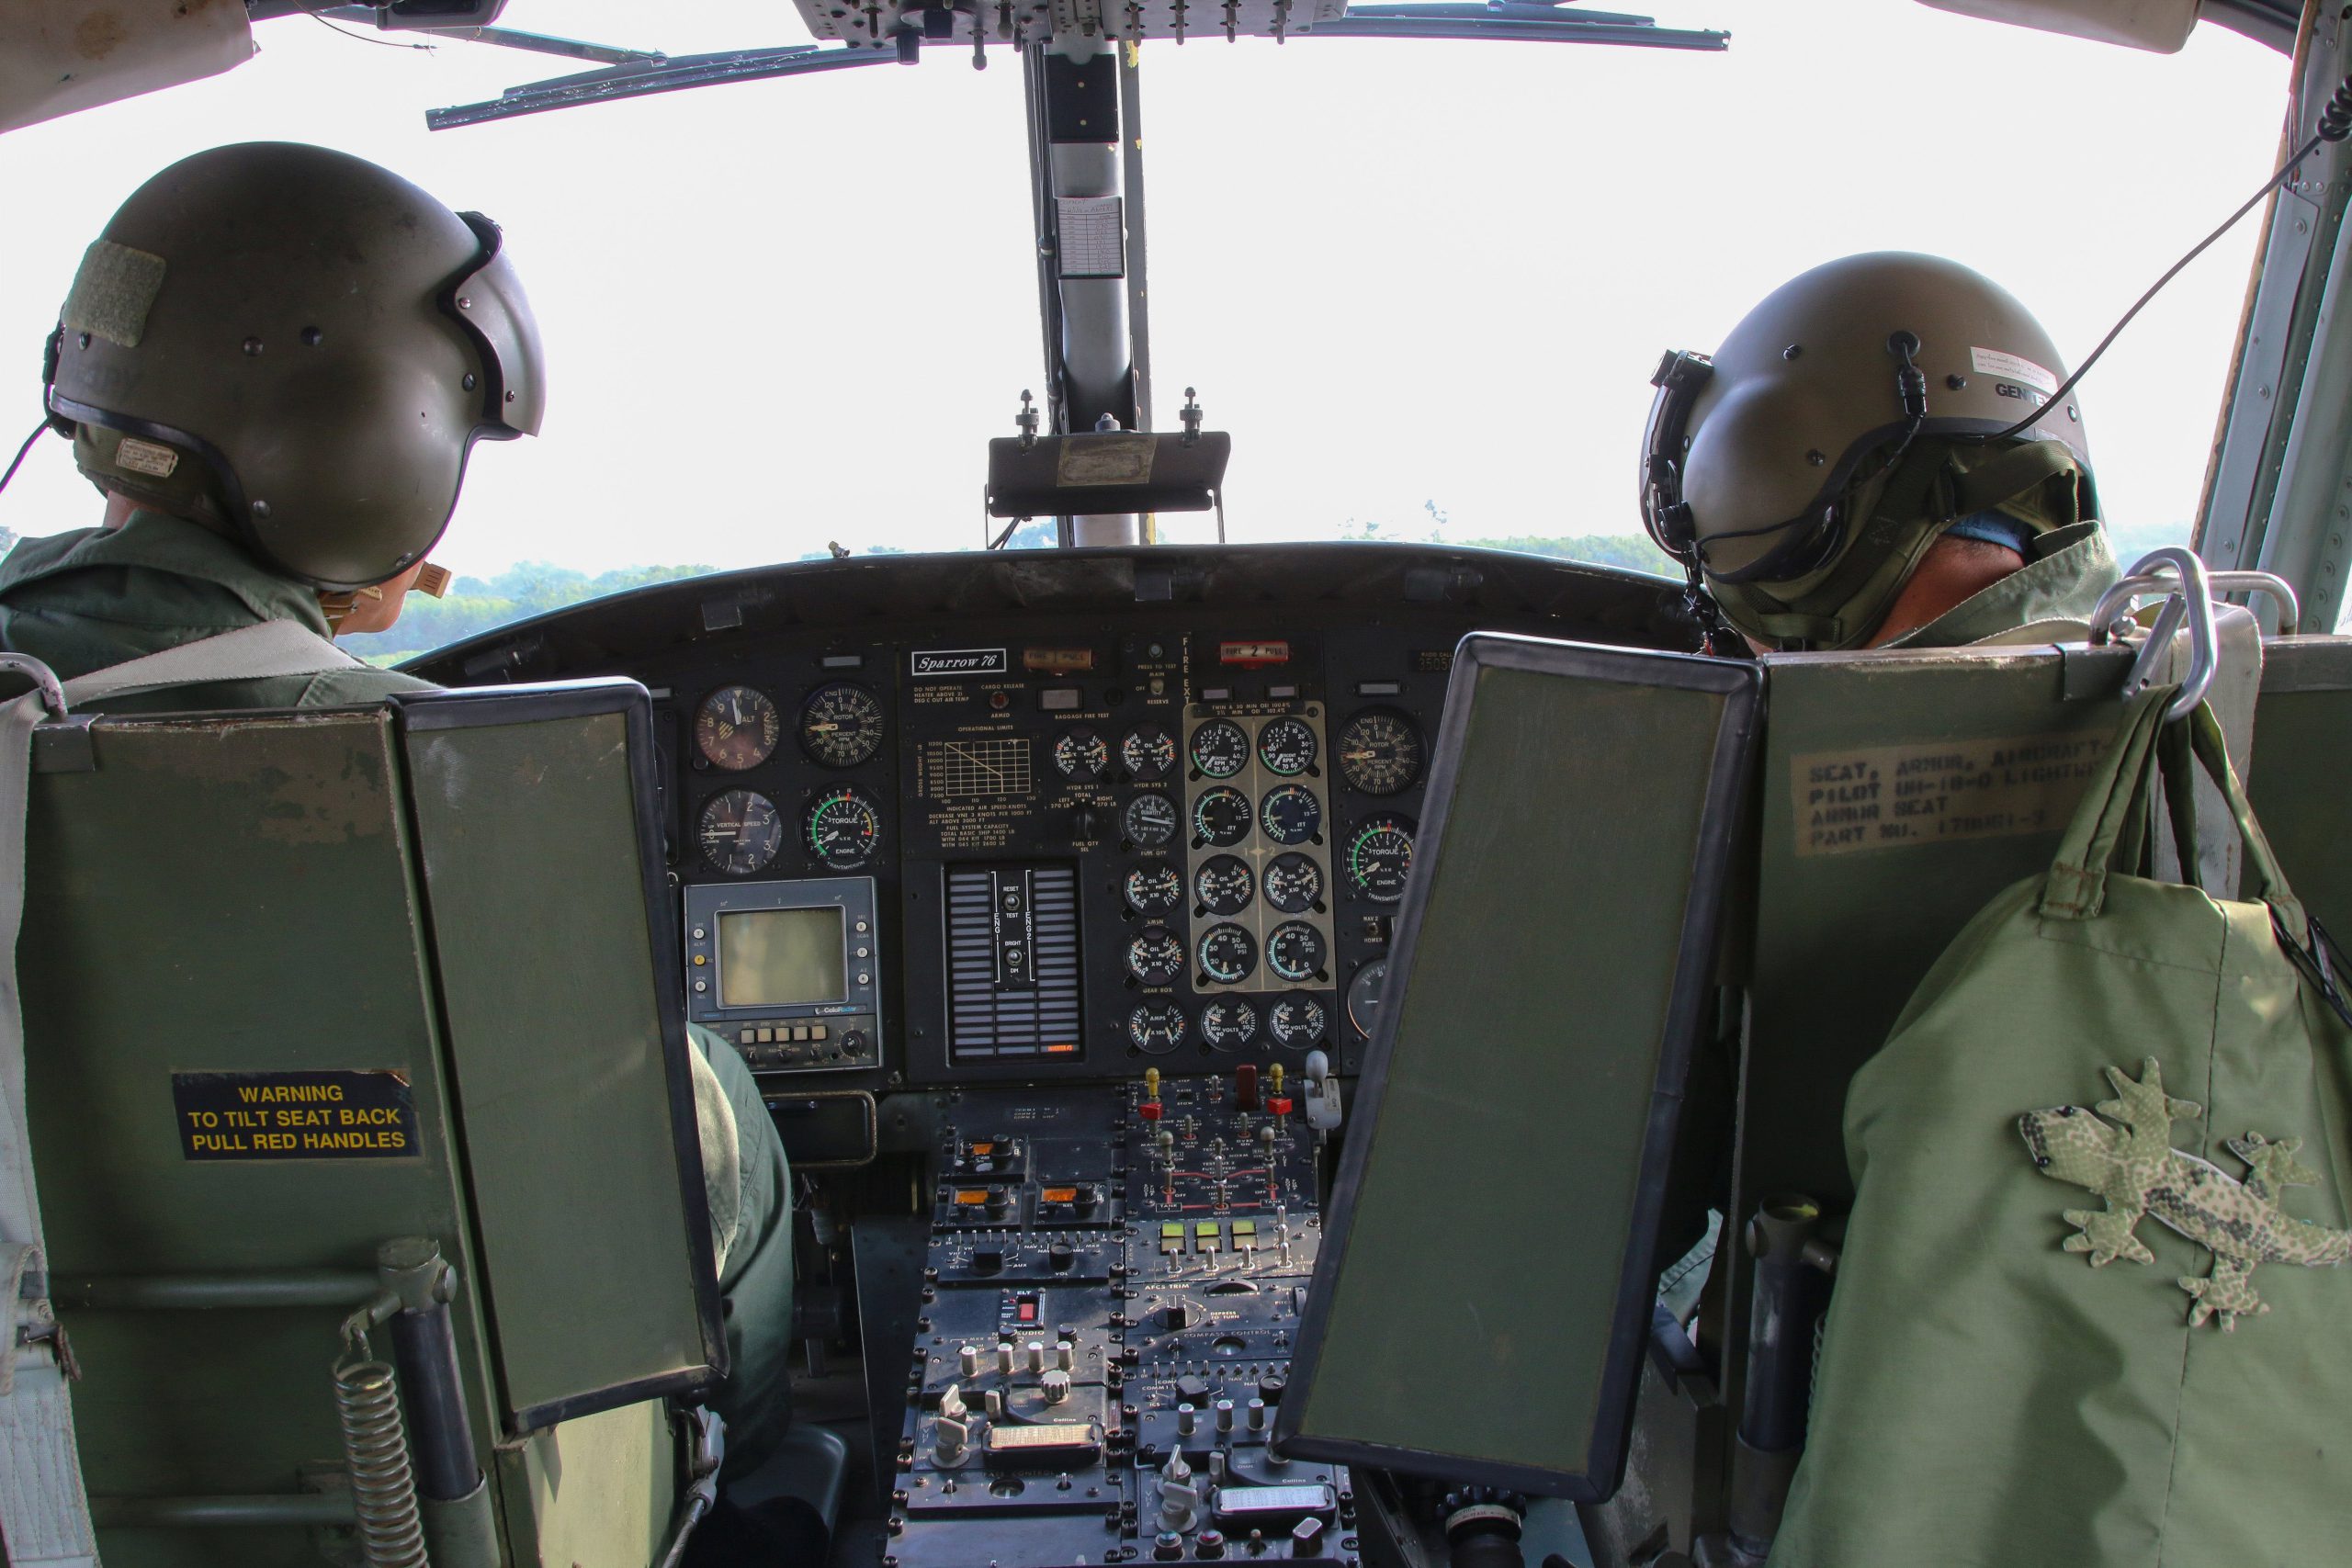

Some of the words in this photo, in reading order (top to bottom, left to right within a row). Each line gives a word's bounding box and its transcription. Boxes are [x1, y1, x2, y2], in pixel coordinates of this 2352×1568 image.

[1226, 647, 1242, 655] FIRE
[1250, 645, 1258, 657] 2
[1265, 647, 1283, 655] PULL
[918, 656, 978, 671] Sparrow
[980, 654, 998, 667] 76
[718, 704, 725, 714] 9
[707, 717, 714, 728] 8
[741, 715, 755, 723] ALT
[708, 736, 714, 746] 7
[719, 749, 727, 759] 6
[737, 753, 744, 763] 5
[752, 748, 761, 757] 4
[1809, 761, 1879, 783] SEAT,
[1809, 783, 1882, 805] PILOT
[746, 802, 753, 812] 2
[1810, 805, 1880, 826] ARMOR
[1894, 796, 1949, 817] SEAT
[763, 815, 770, 825] 3
[1811, 826, 1866, 846] PART
[763, 840, 771, 851] 3
[238, 1085, 344, 1103] WARNING
[188, 1111, 219, 1128] TO
[224, 1111, 269, 1128] TILT
[277, 1110, 333, 1127] SEAT
[340, 1108, 401, 1125] BACK
[192, 1134, 248, 1151] PULL
[254, 1133, 298, 1150] RED
[303, 1132, 406, 1149] HANDLES
